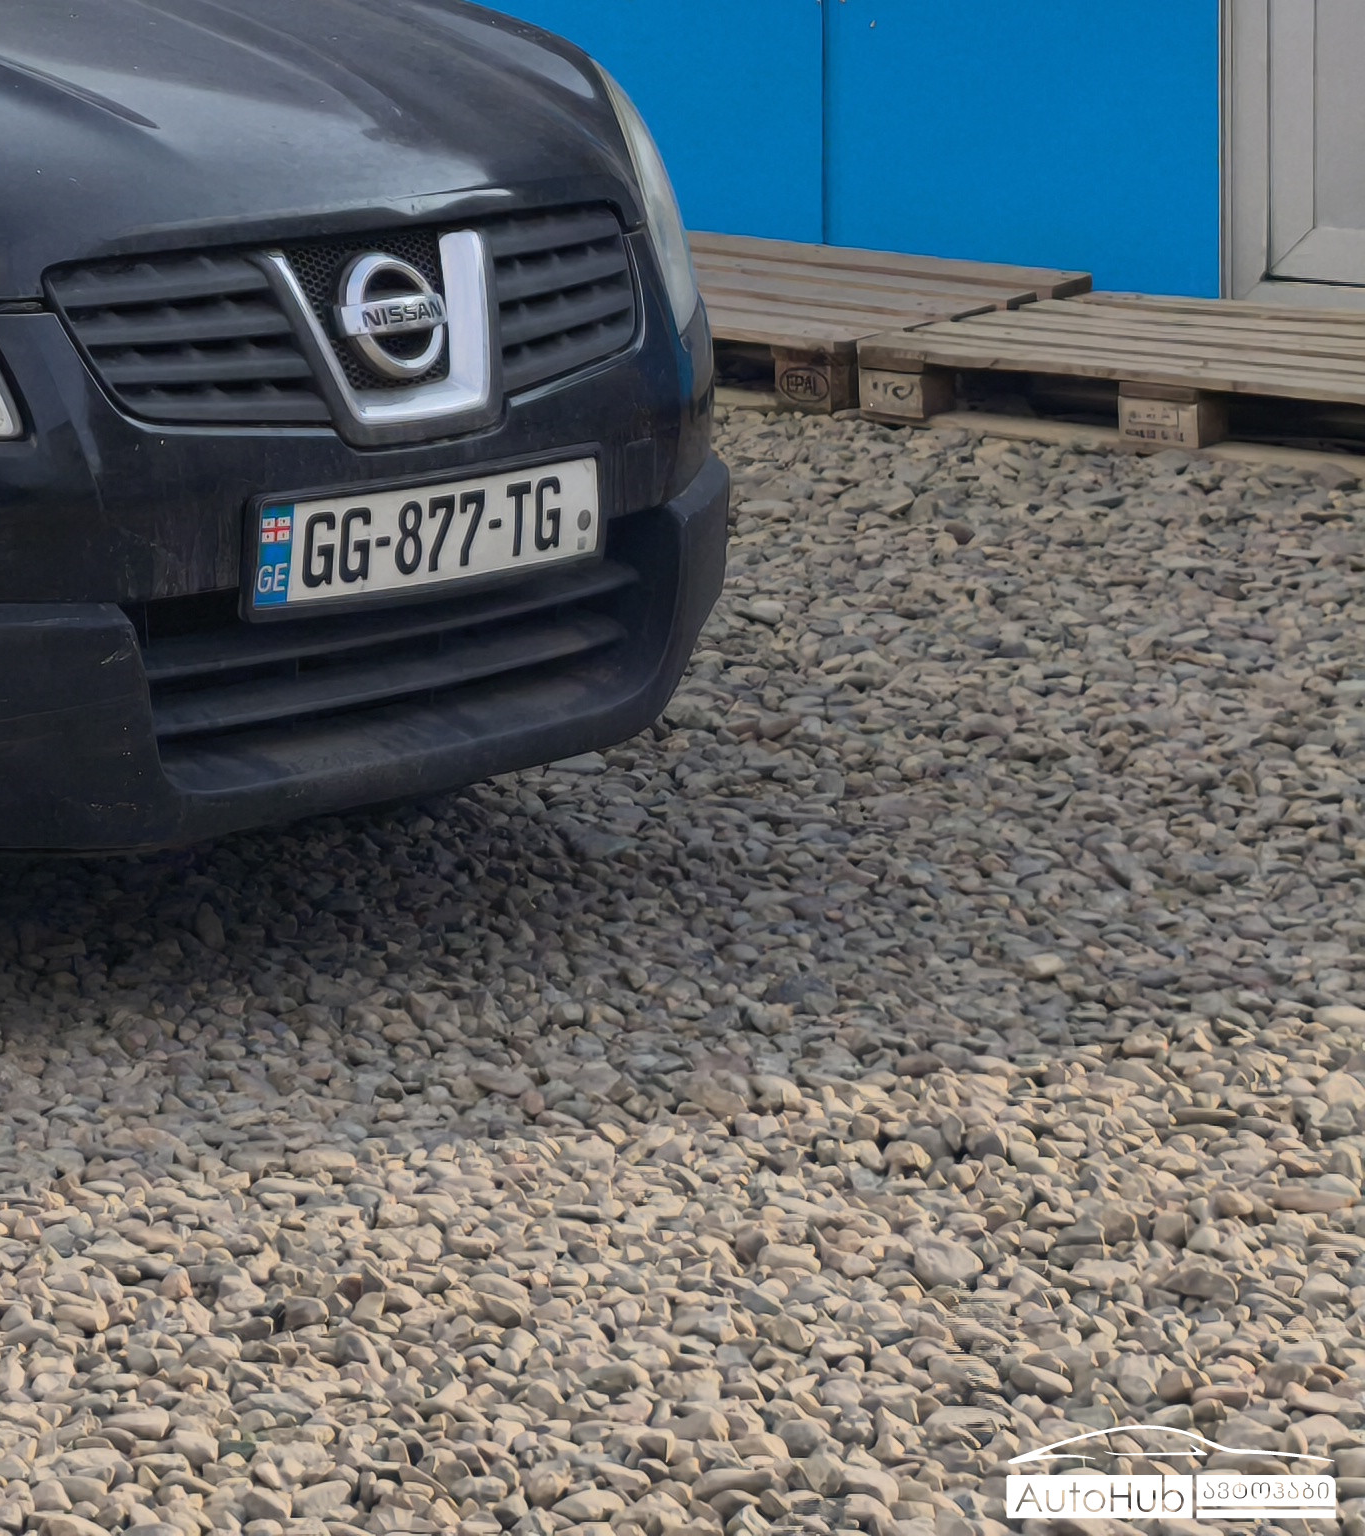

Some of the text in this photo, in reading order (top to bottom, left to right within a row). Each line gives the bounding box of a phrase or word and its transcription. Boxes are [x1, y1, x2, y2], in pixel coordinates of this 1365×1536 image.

[361, 299, 444, 328] NISSAN
[302, 476, 561, 588] GG-877-TG
[257, 562, 288, 594] GE
